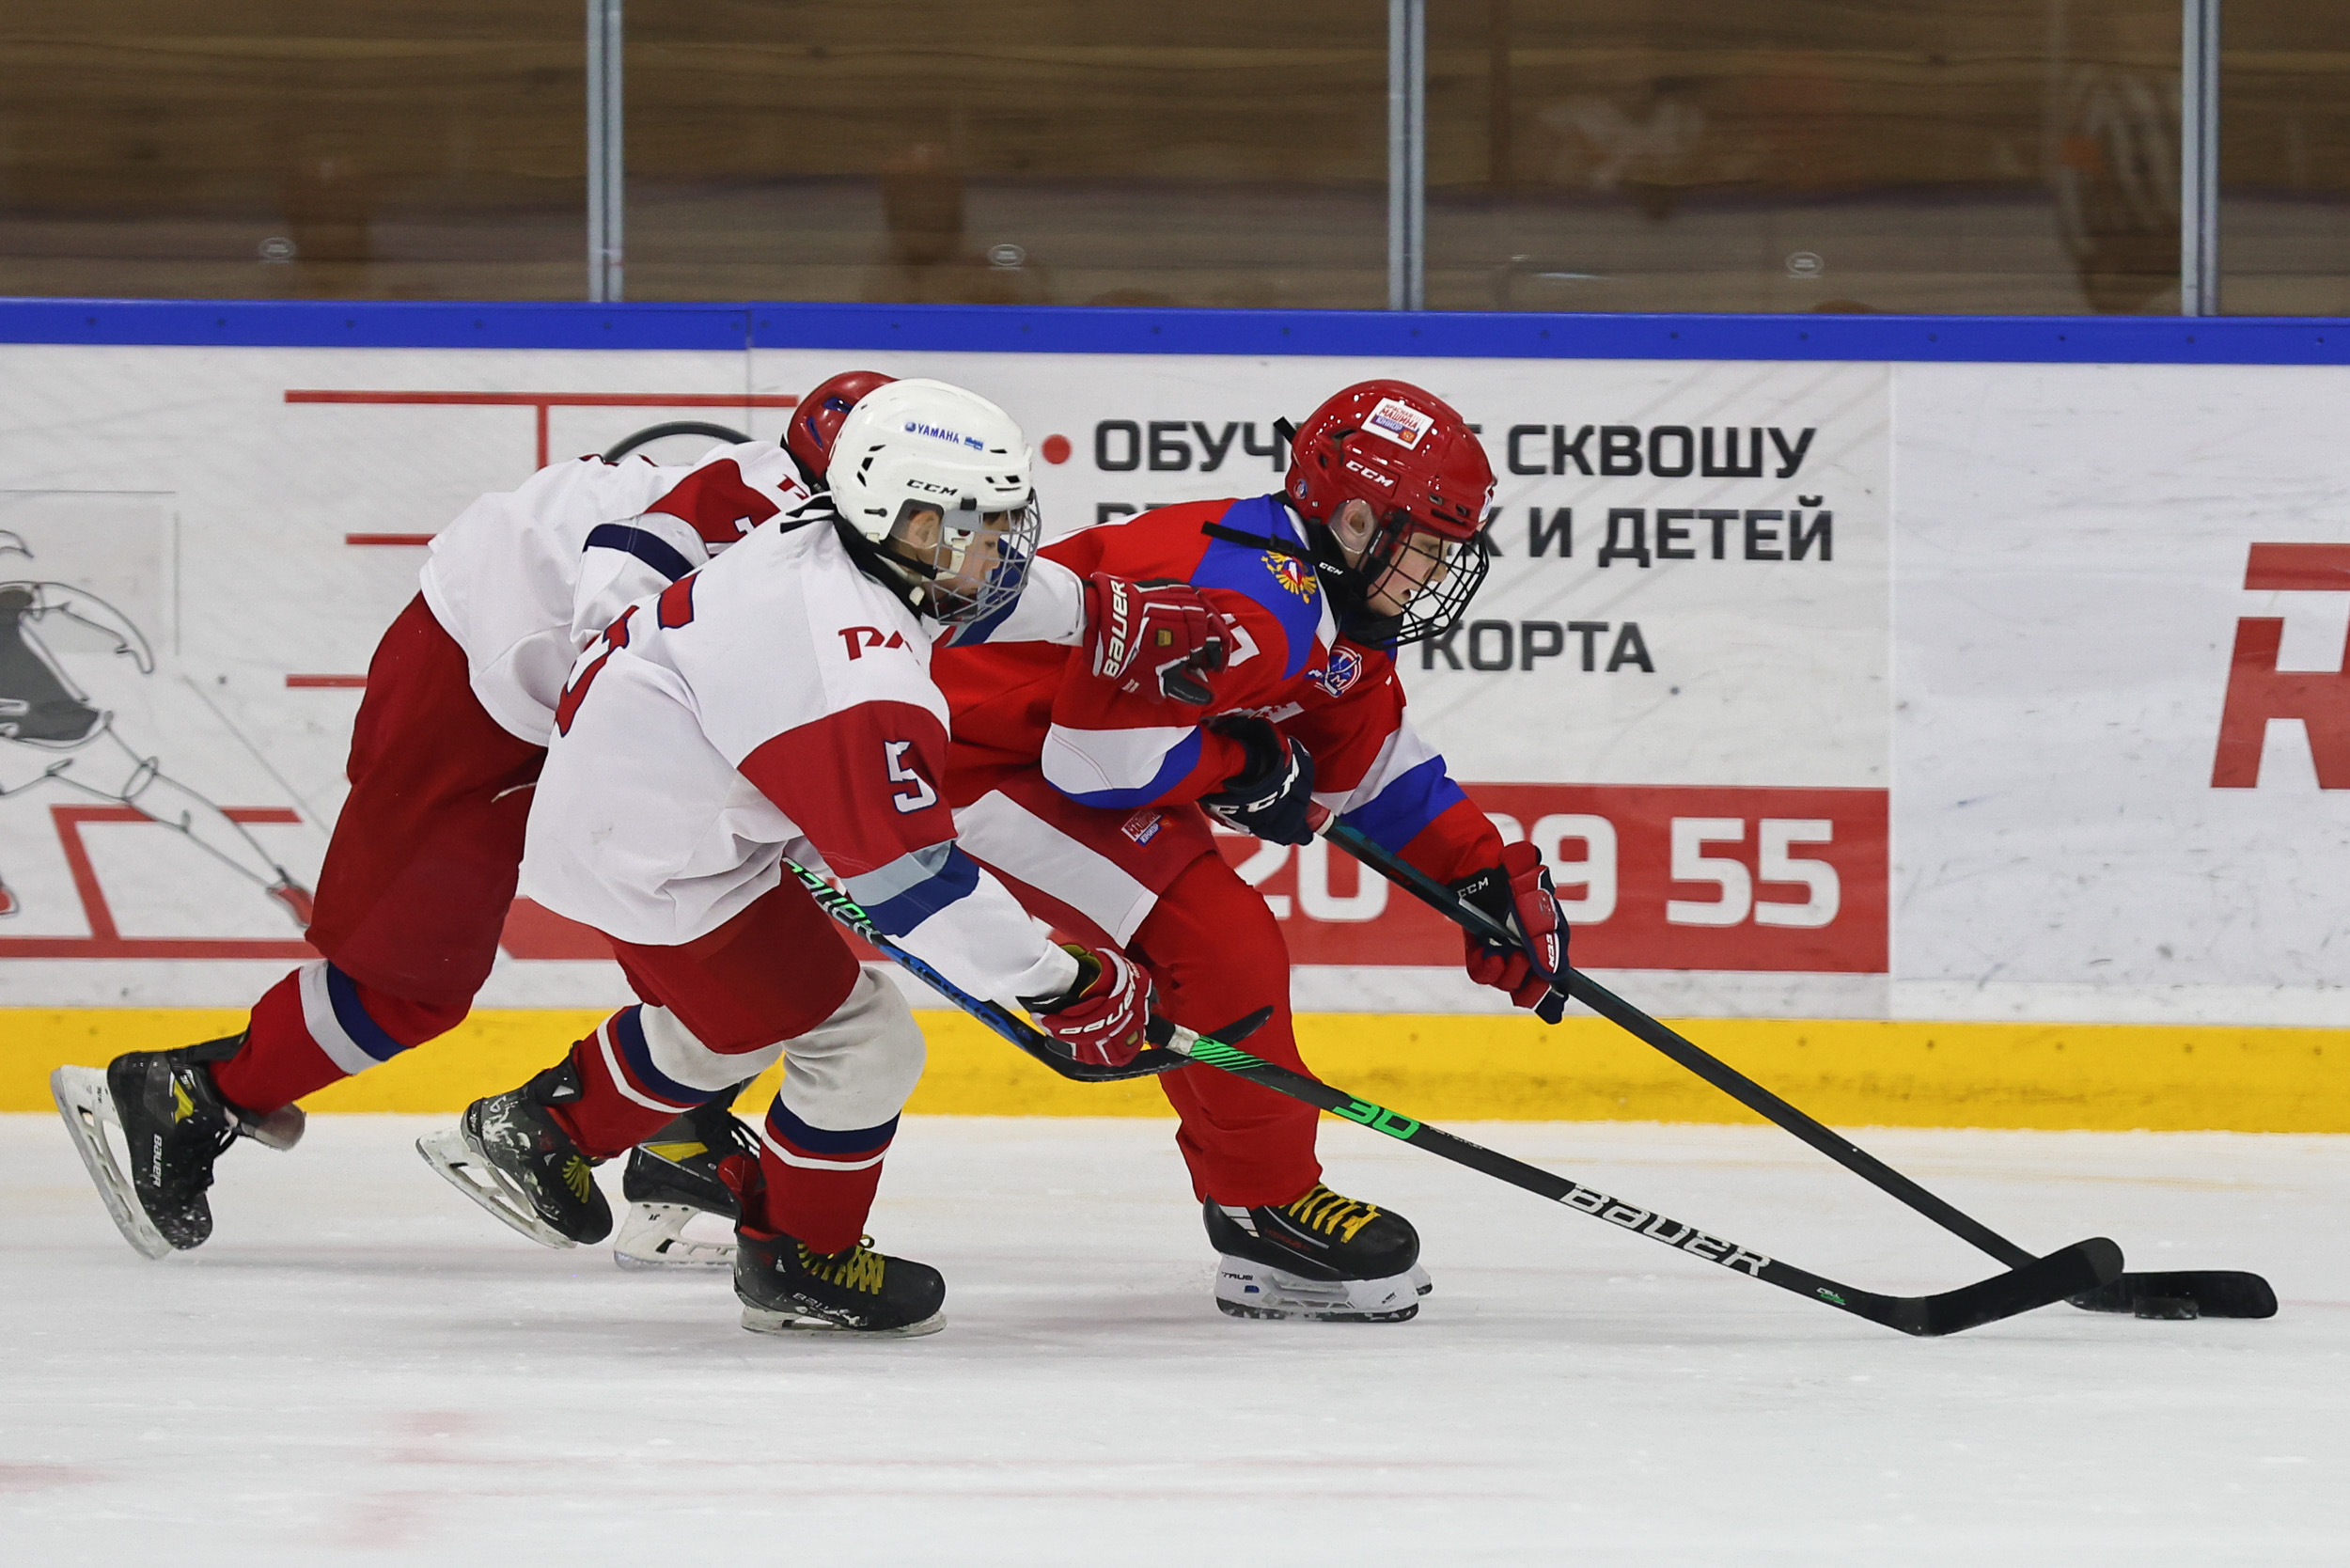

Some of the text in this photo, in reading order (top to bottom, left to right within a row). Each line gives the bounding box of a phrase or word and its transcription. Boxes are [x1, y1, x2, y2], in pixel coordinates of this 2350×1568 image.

[916, 423, 960, 444] YAMAHA
[1378, 407, 1418, 430] МАШИНА
[1345, 459, 1395, 488] CCM
[1507, 424, 1816, 478] СКВОШУ
[906, 478, 959, 496] CCM
[1528, 507, 1573, 558] И
[1597, 494, 1834, 569] ДЕТЕЙ
[1319, 561, 1344, 576] CCM
[1102, 579, 1129, 678] BAUER
[1421, 619, 1656, 673] КОРТА
[884, 740, 937, 814] 5
[1207, 753, 1301, 815] CCM
[1457, 876, 1489, 898] CCM
[1666, 817, 1841, 928] 55
[1544, 933, 1555, 968] CCM
[153, 1133, 164, 1188] BAUER
[1559, 1183, 1771, 1277] BAUER
[1222, 1270, 1254, 1281] TRUE
